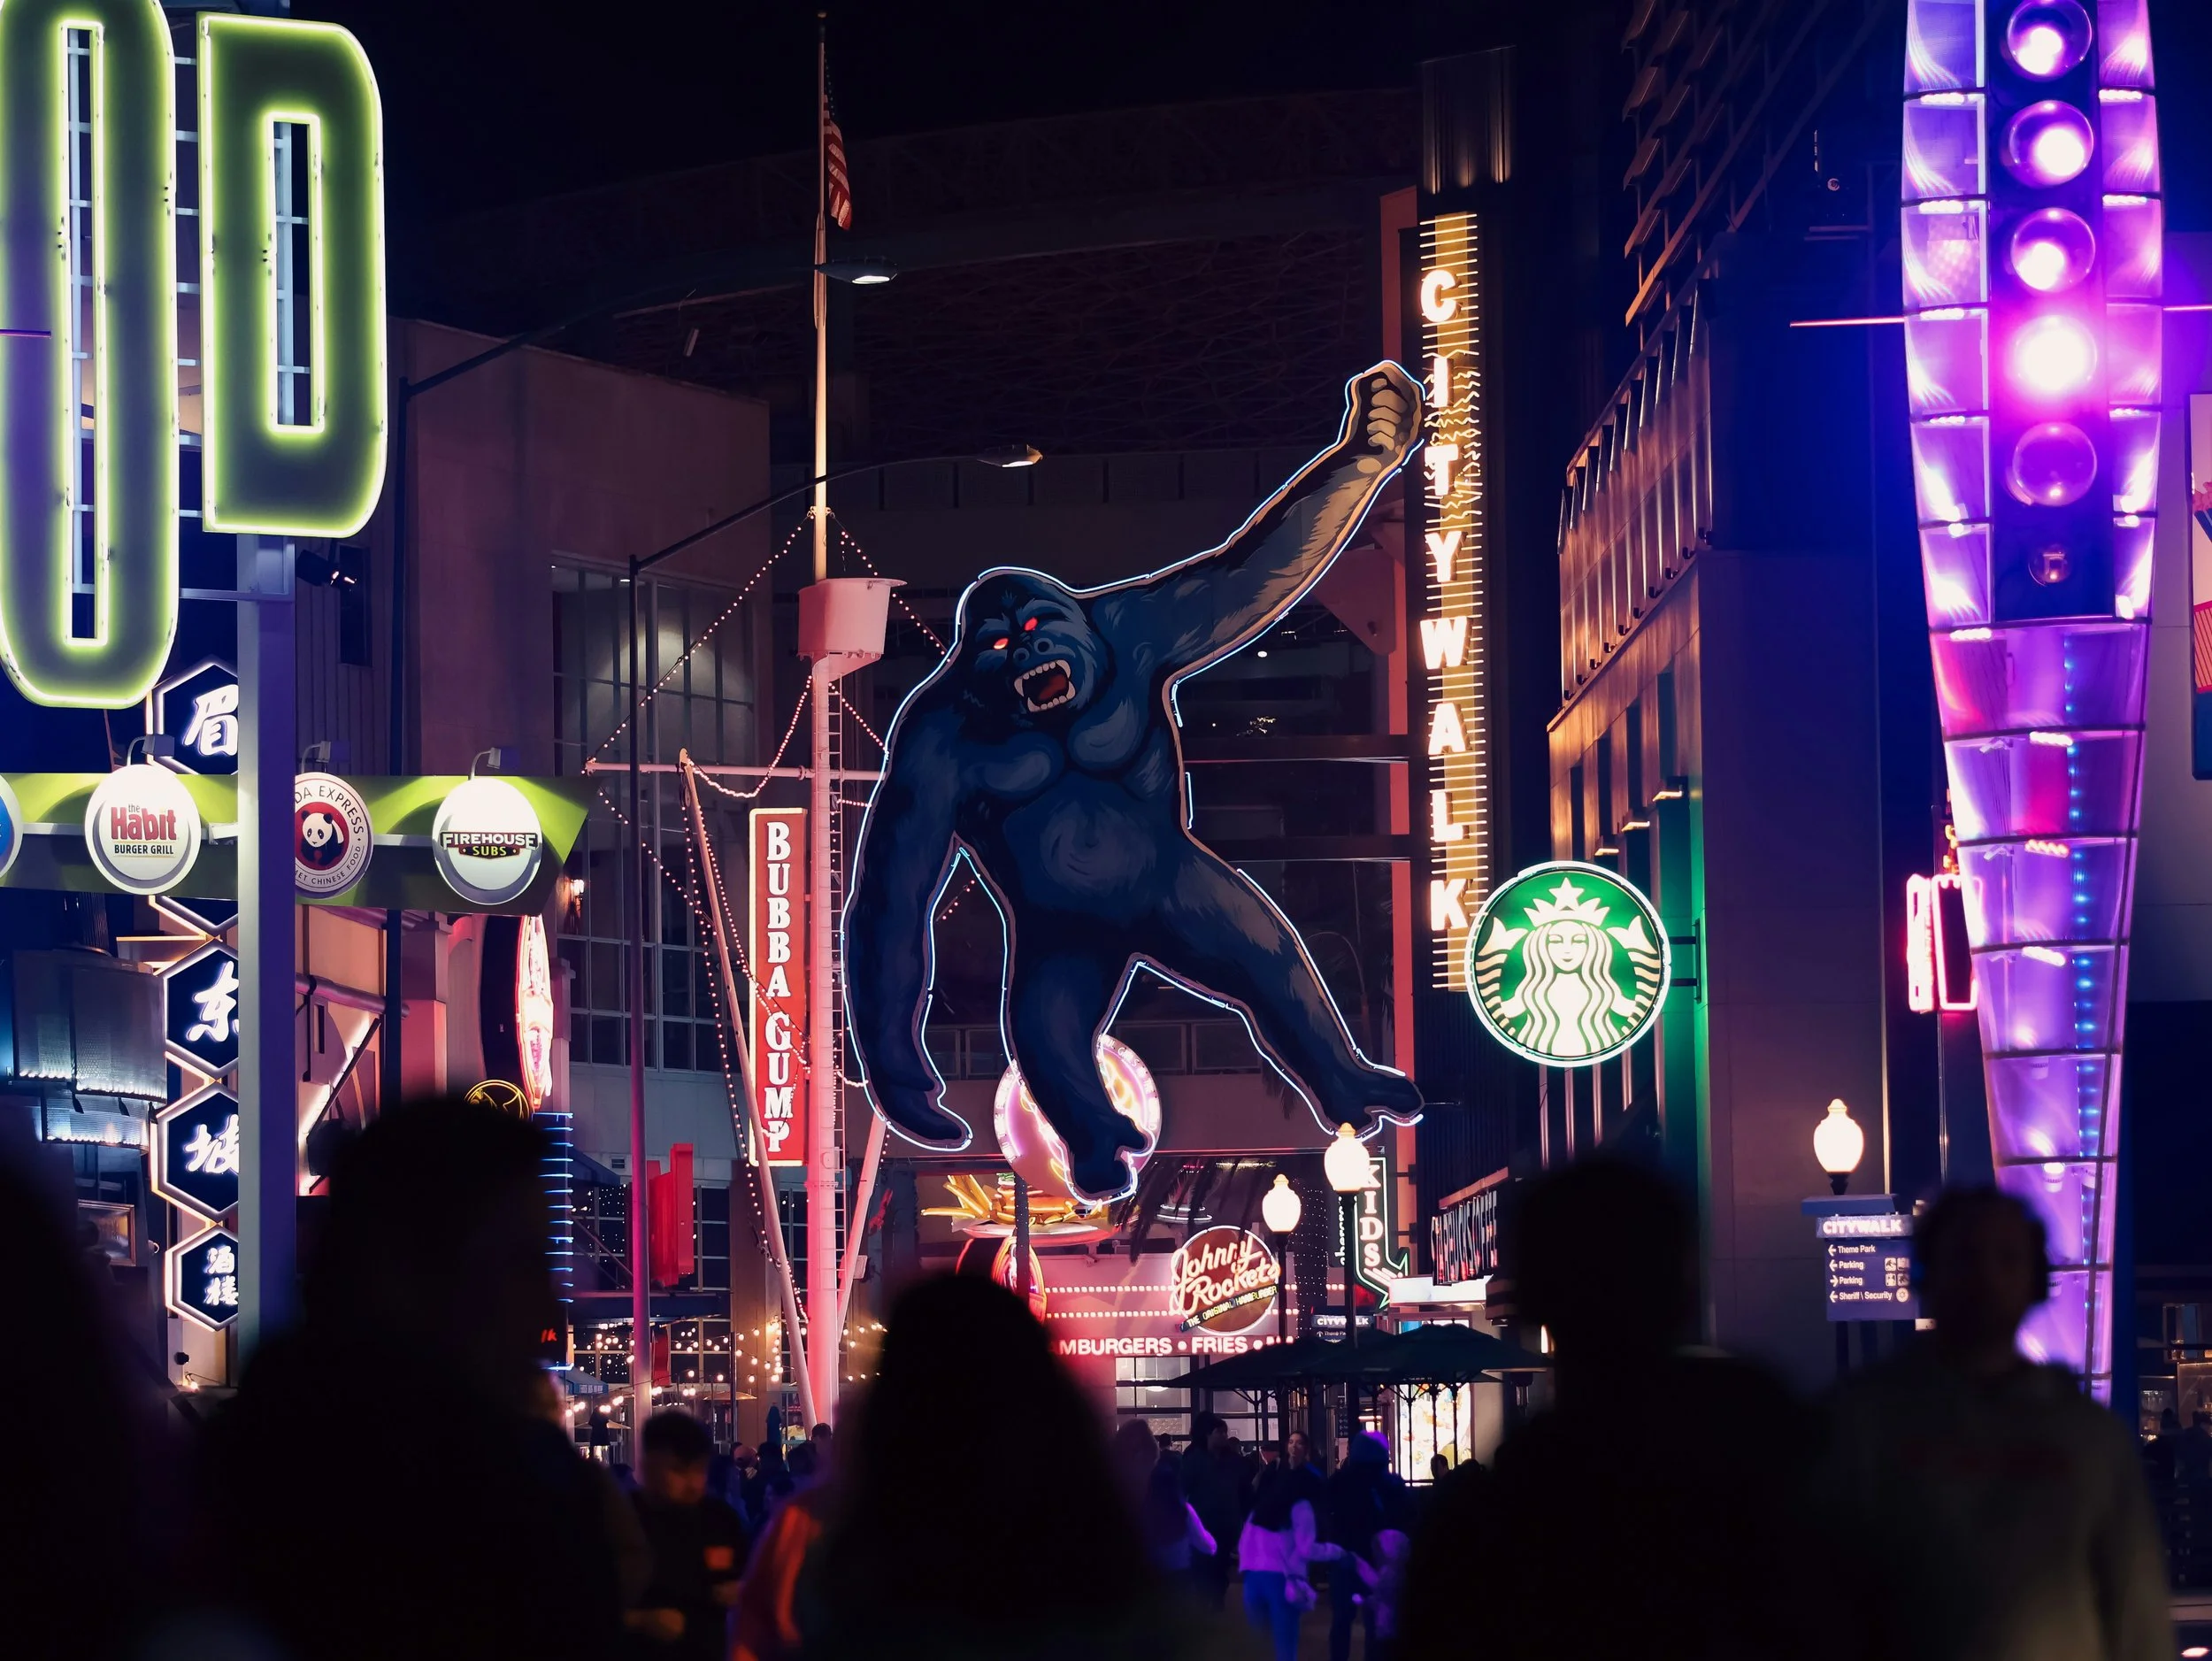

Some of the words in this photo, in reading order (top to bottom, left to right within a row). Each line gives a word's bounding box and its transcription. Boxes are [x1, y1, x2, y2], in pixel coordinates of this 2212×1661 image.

[1419, 269, 1469, 933] CITYWALK
[128, 804, 140, 812] the
[319, 785, 364, 834] EXPRESS
[111, 806, 176, 841] Habit
[114, 844, 148, 854] BURGER
[150, 845, 174, 855] GRILL
[442, 833, 536, 850] FIREHOUSE
[472, 846, 507, 856] SUBS
[311, 872, 345, 885] CHINESE
[347, 846, 361, 870] FOOD
[765, 821, 792, 998] BUBBA
[764, 1013, 794, 1153] GUMP
[1359, 1165, 1384, 1266] KIDS
[1823, 1219, 1901, 1234] CITYWALK
[1838, 1245, 1859, 1254] Theme
[1860, 1244, 1876, 1253] Park
[1169, 1234, 1263, 1313] Johnny
[1839, 1261, 1864, 1271] Parking
[1186, 1257, 1281, 1314] Rockets
[1839, 1277, 1863, 1286] Parking
[1839, 1292, 1860, 1301] Sheriff
[1864, 1291, 1893, 1301] Security
[1187, 1315, 1201, 1327] THE
[1059, 1337, 1172, 1356] MBURGERS
[1191, 1336, 1248, 1355] FRIES
